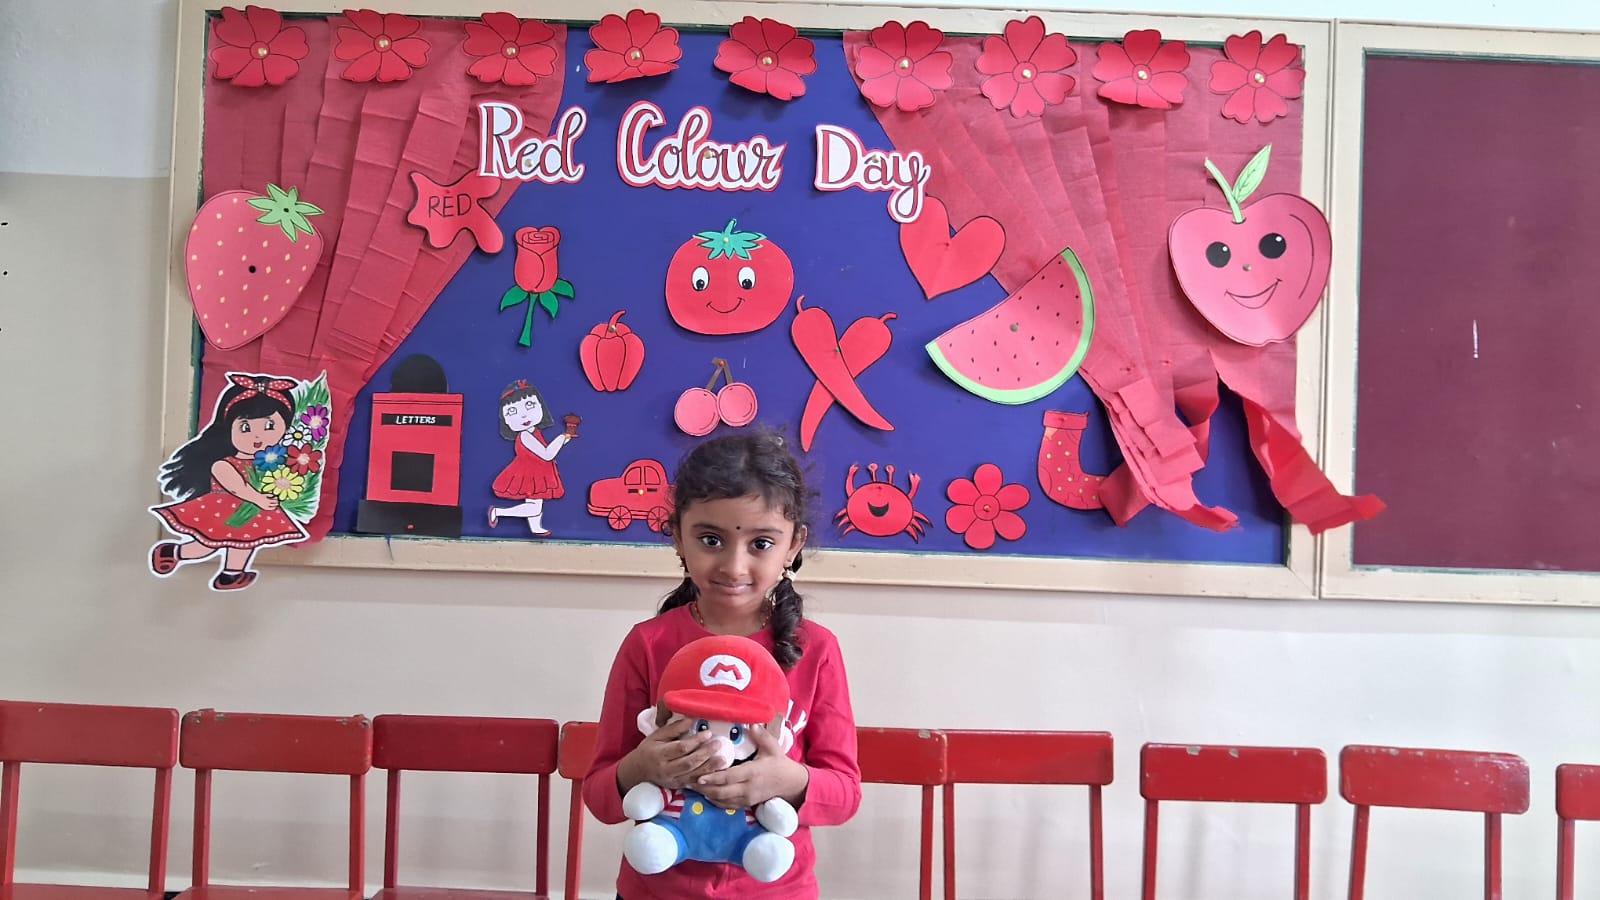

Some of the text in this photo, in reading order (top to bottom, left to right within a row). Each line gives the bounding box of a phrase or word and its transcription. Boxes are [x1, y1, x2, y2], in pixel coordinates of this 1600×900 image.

[479, 104, 928, 218] Red Colour Day
[428, 193, 472, 218] RED
[395, 415, 437, 425] LETTERS
[708, 662, 743, 681] M
